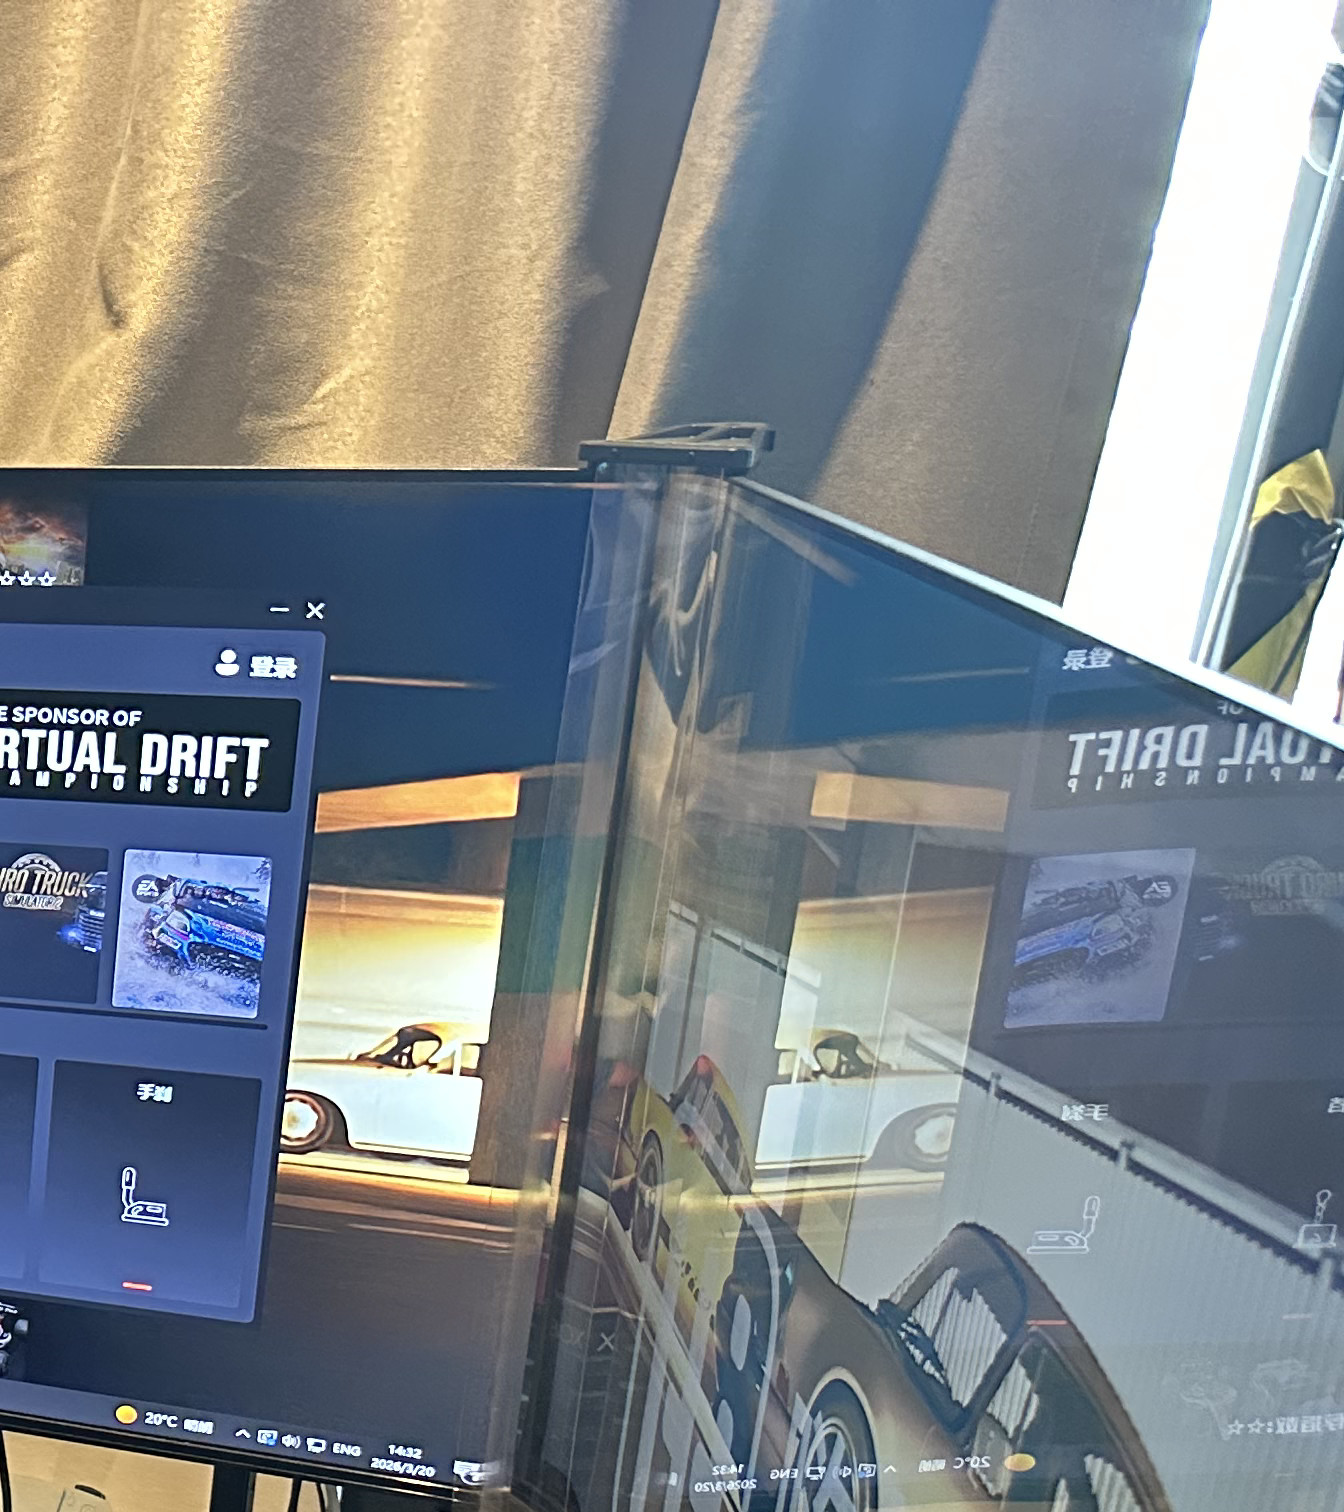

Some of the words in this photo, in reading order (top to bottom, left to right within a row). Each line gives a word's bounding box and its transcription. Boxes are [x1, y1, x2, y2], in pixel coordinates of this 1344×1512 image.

[249, 655, 298, 680] 登录
[11, 705, 110, 727] SPONSOR
[112, 709, 143, 729] OF
[140, 734, 270, 781] DRIFT
[31, 869, 91, 898] TRUCK
[332, 1443, 362, 1458] ENG
